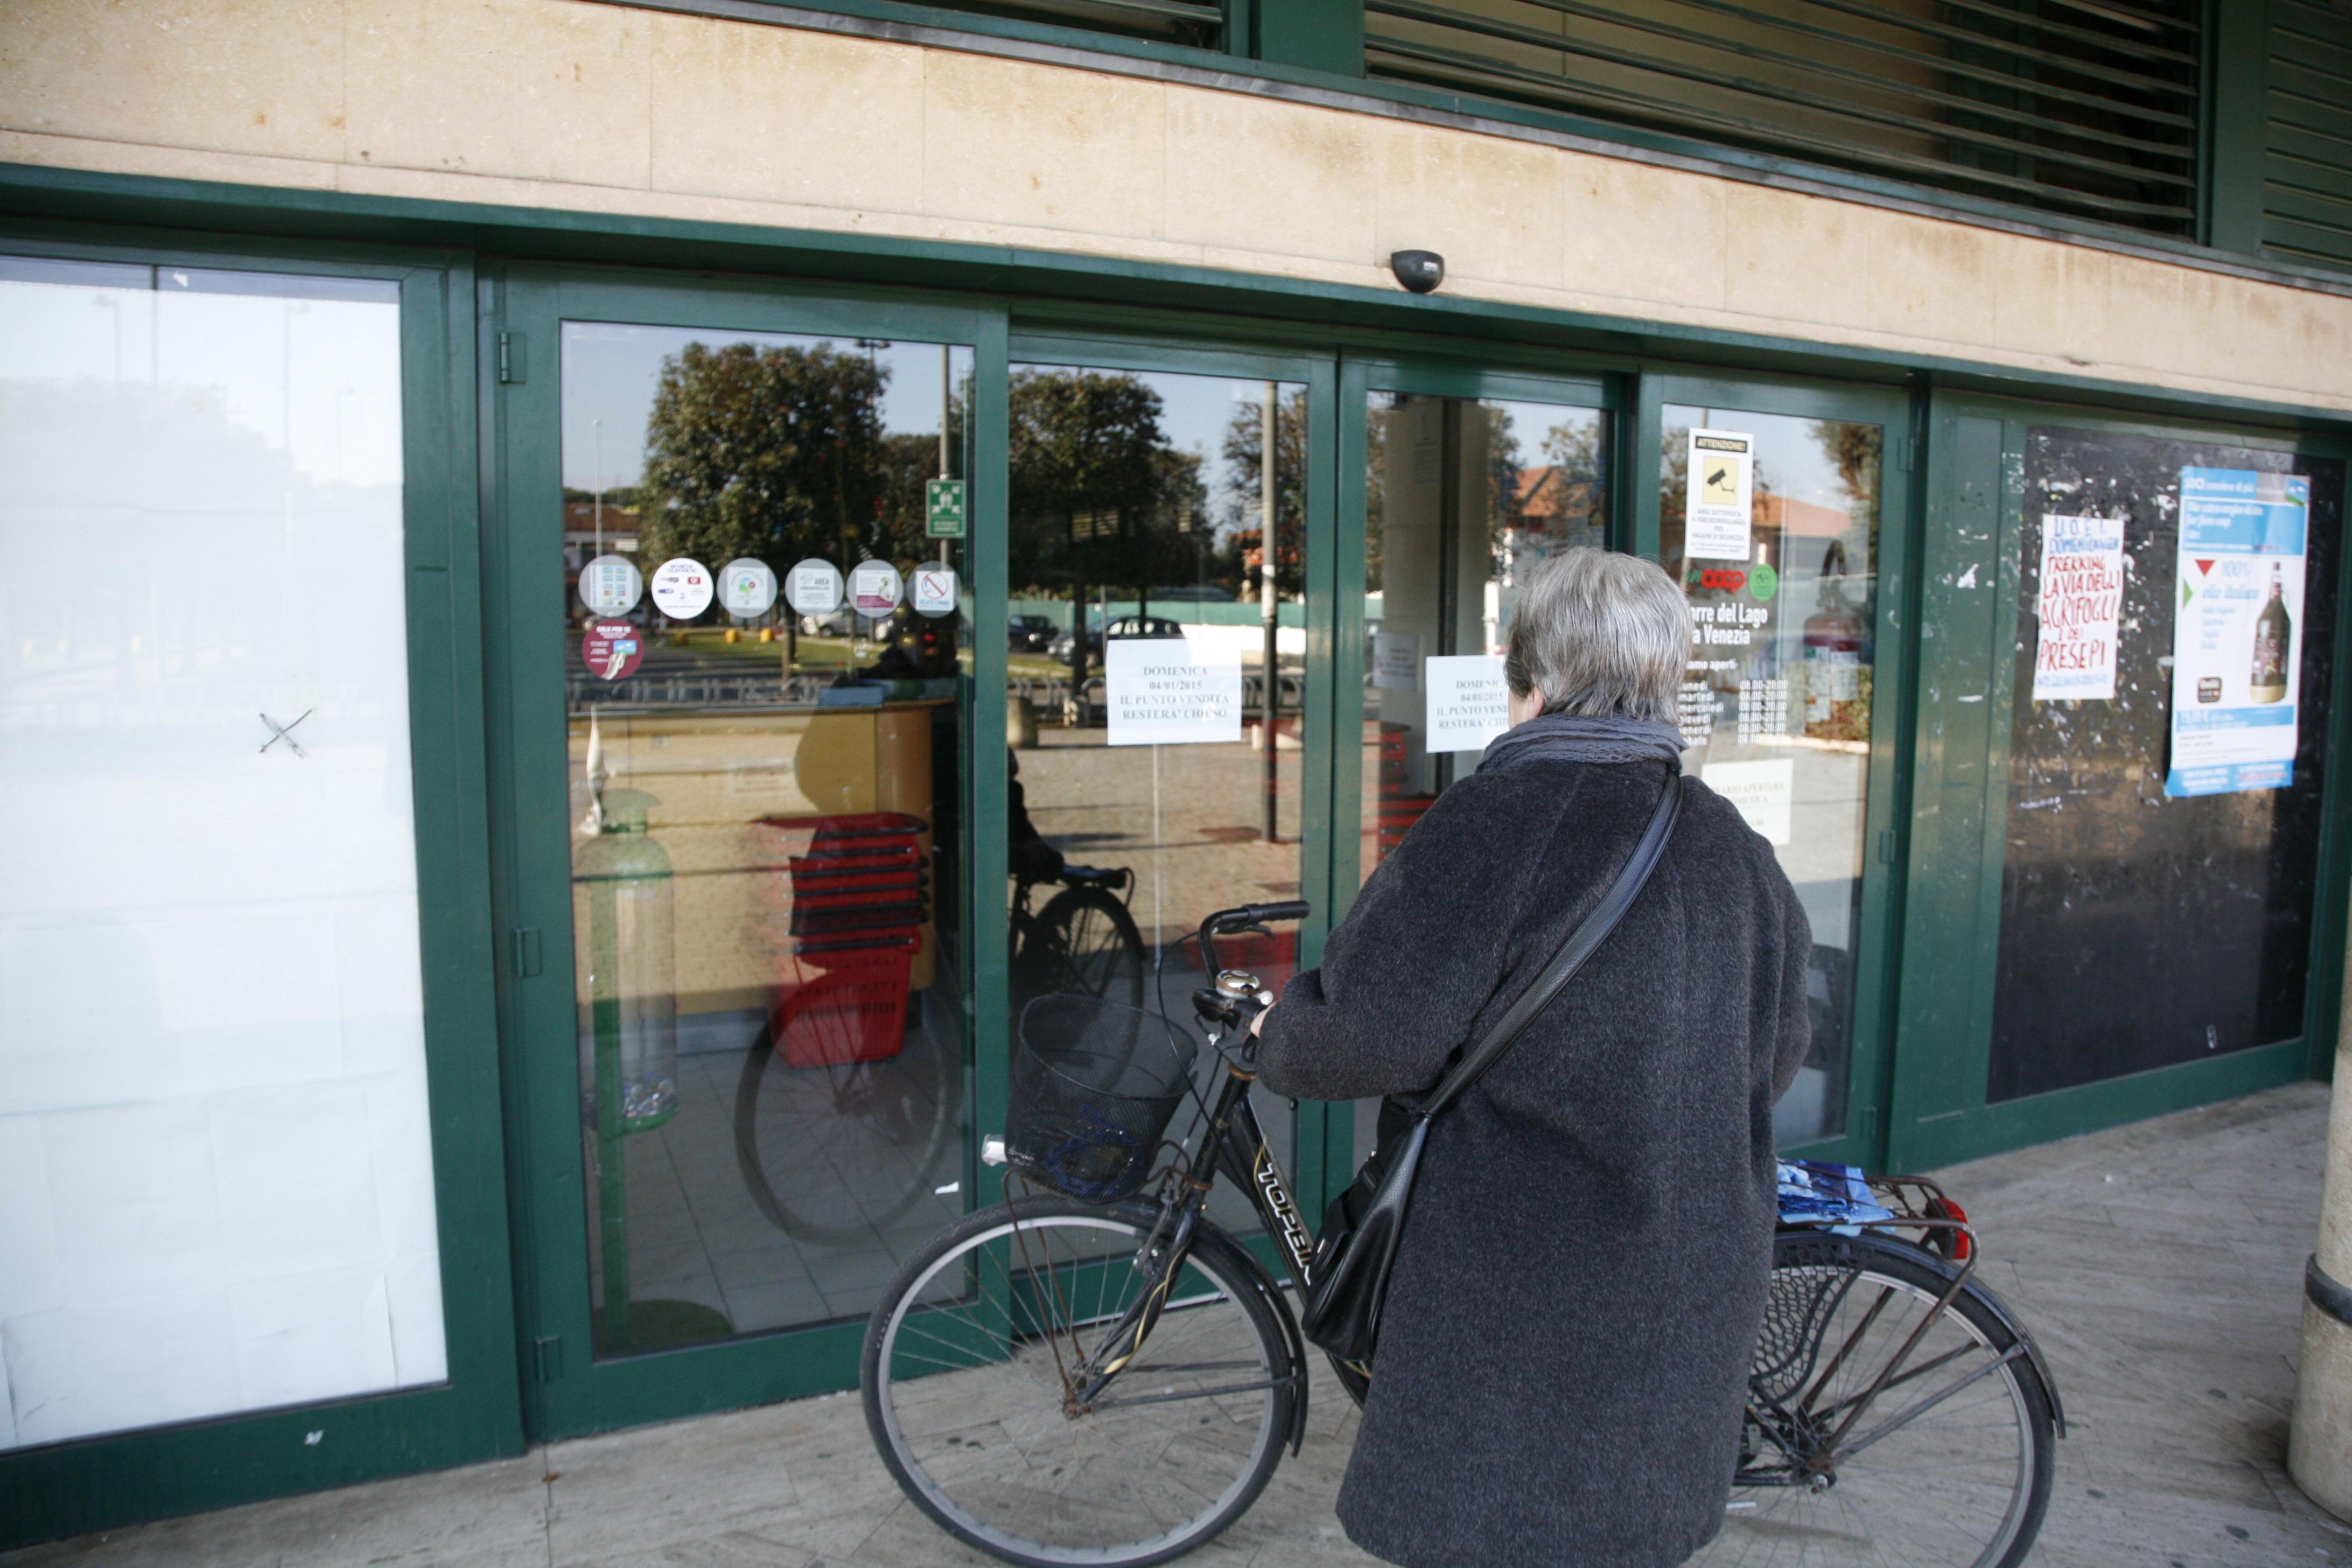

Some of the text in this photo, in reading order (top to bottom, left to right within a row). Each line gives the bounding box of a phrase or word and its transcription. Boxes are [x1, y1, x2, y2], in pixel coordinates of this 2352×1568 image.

[2048, 556, 2105, 575] TREKKING
[1717, 602, 1737, 623] del
[1739, 602, 1768, 629] Lago
[1703, 624, 1751, 645] Venezia
[2038, 639, 2105, 671] PRESEPI
[1143, 666, 1208, 676] DOMENICA
[1149, 680, 1202, 690] 04/01/2015
[1455, 680, 1500, 689] DOMENIC
[1120, 694, 1229, 705] IL PUNTO VENDITA
[1184, 708, 1227, 718] CHIUSO
[1437, 705, 1508, 716] IL PUNTO VEND
[1711, 785, 1742, 794] RARIO
